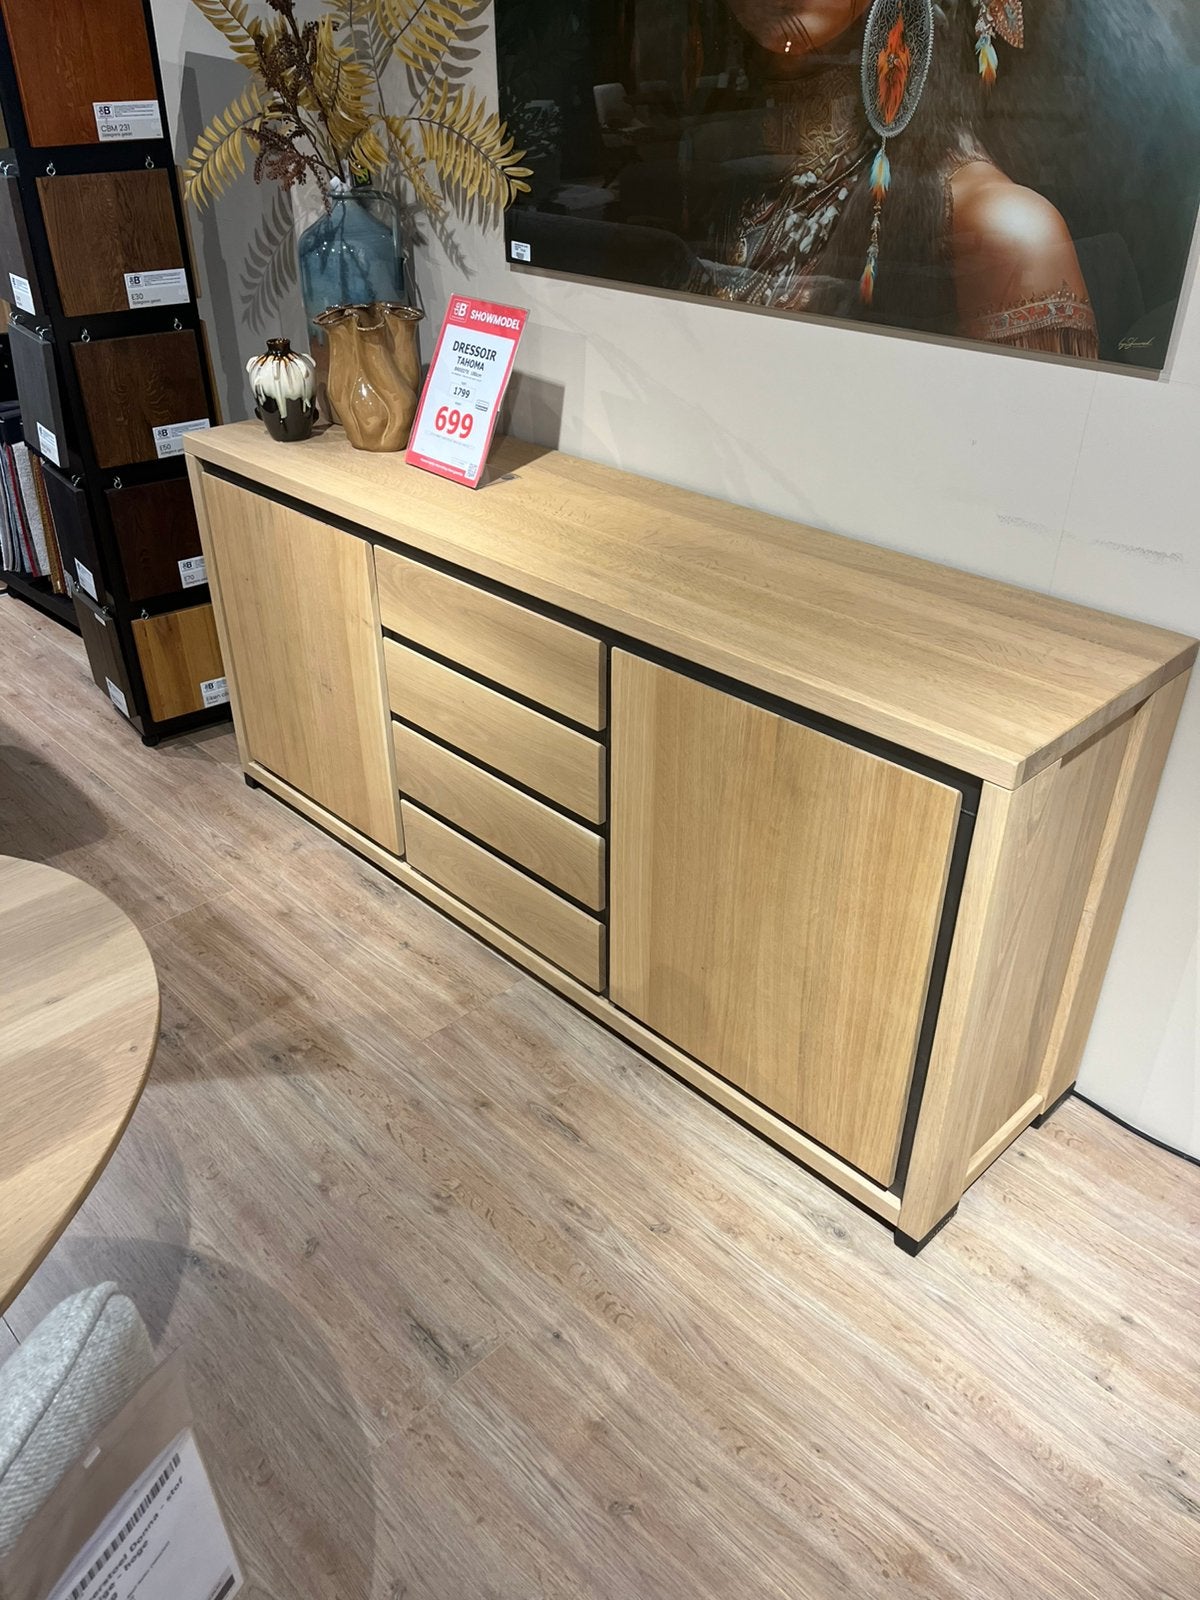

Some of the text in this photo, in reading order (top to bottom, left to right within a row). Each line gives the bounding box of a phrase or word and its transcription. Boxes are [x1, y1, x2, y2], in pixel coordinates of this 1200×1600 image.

[101, 123, 131, 132] CBM 231
[470, 309, 520, 331] SHOWMODEL
[452, 340, 497, 362] DRESSOIR
[457, 355, 485, 371] TAHOMA
[453, 386, 471, 399] 1799
[435, 405, 474, 439] 699
[129, 1512, 159, 1552] Donna
